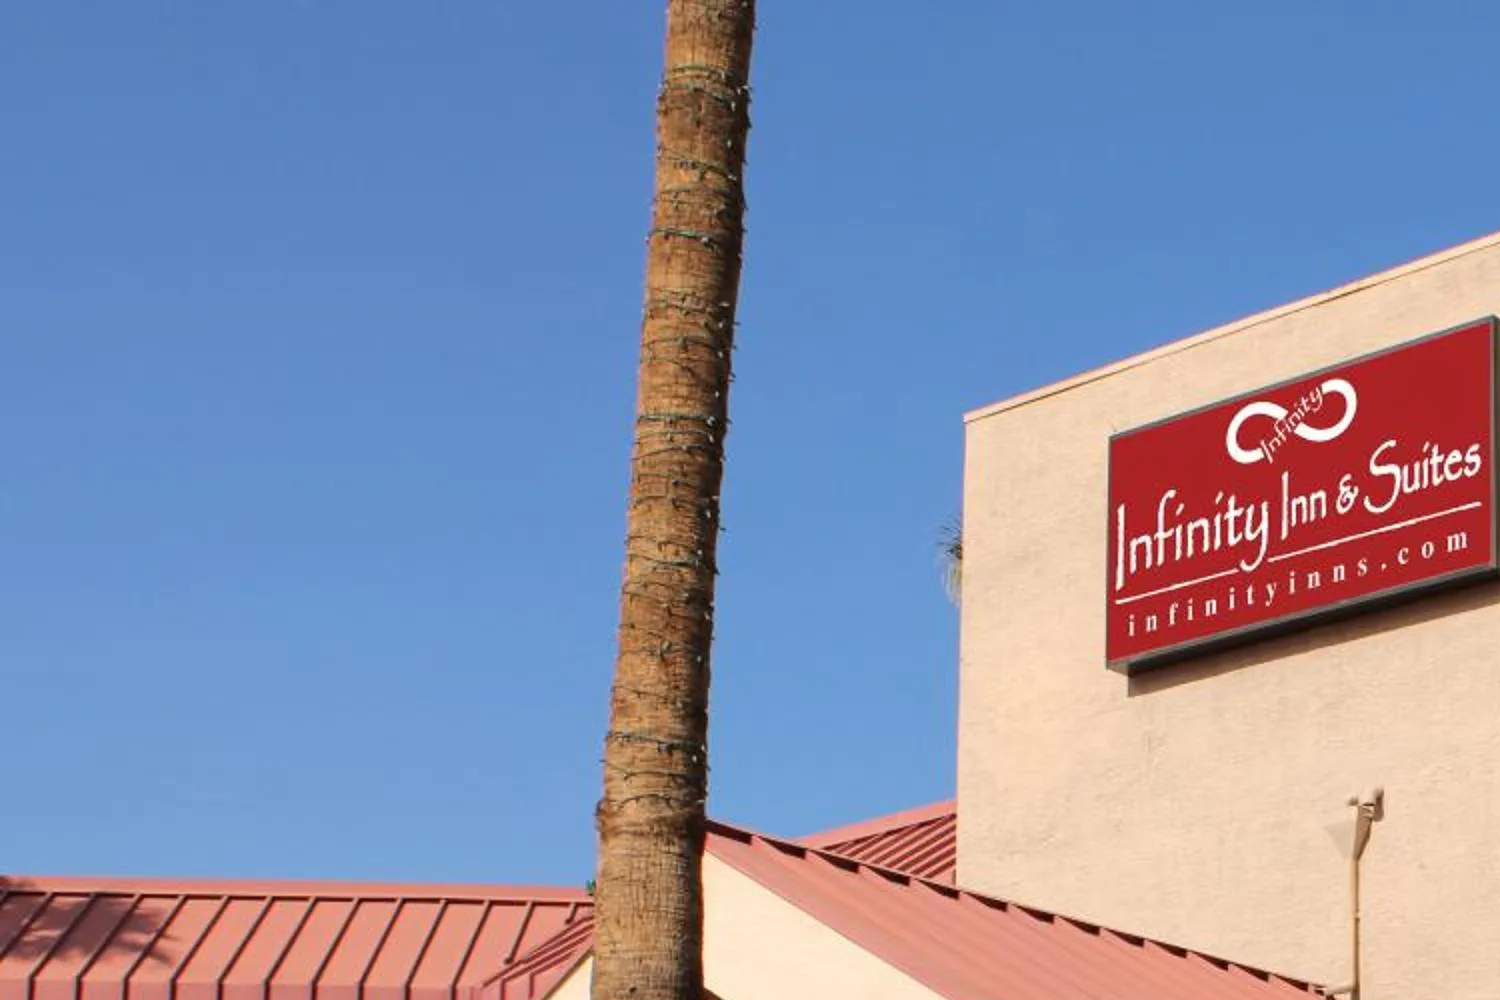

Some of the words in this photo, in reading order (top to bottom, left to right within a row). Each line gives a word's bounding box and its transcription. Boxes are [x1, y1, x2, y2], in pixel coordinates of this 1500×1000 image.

[1260, 384, 1324, 464] Infinity
[1115, 489, 1270, 591] Infinity
[1280, 471, 1328, 540] Inn
[1336, 474, 1359, 514] &
[1363, 439, 1482, 514] Suites
[1127, 527, 1468, 637] infinityinns.com
